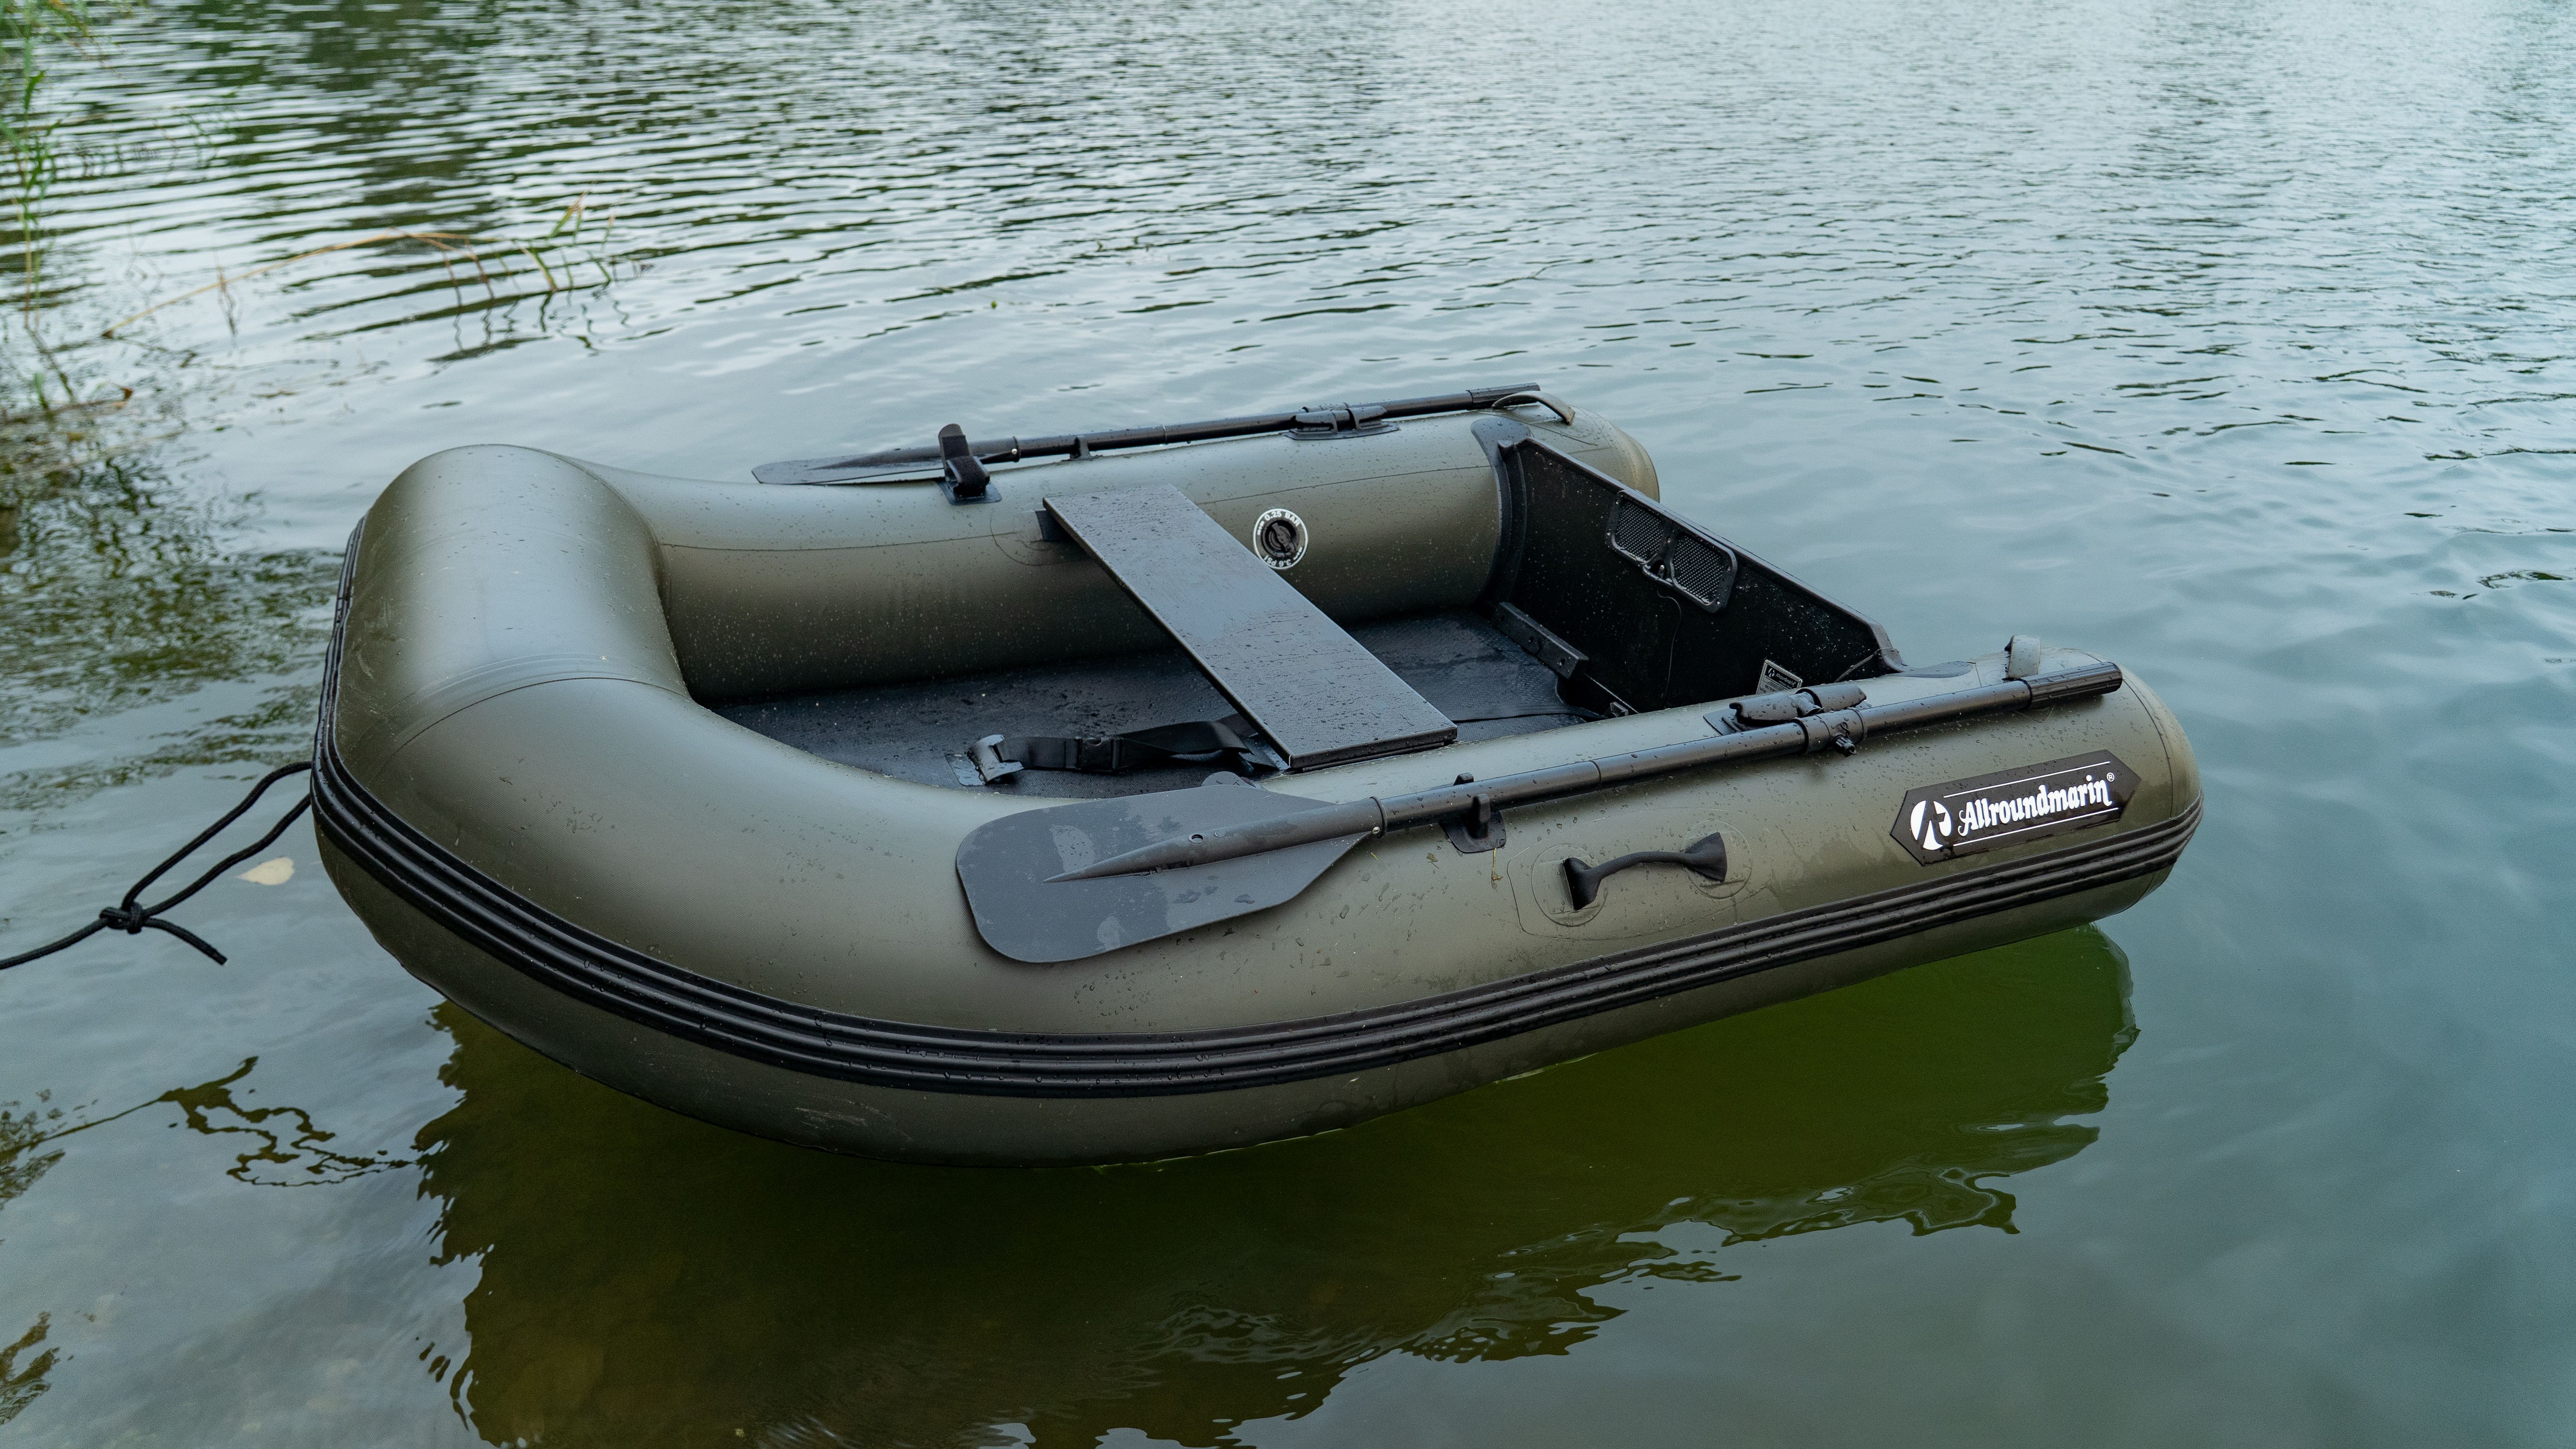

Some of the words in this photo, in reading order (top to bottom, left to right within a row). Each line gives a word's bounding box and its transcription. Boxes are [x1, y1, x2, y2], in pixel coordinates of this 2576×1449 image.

[1264, 511, 1282, 521] 0.25
[1284, 512, 1300, 527] BAR
[1264, 555, 1277, 566] PSI
[1279, 559, 1291, 567] 3.6
